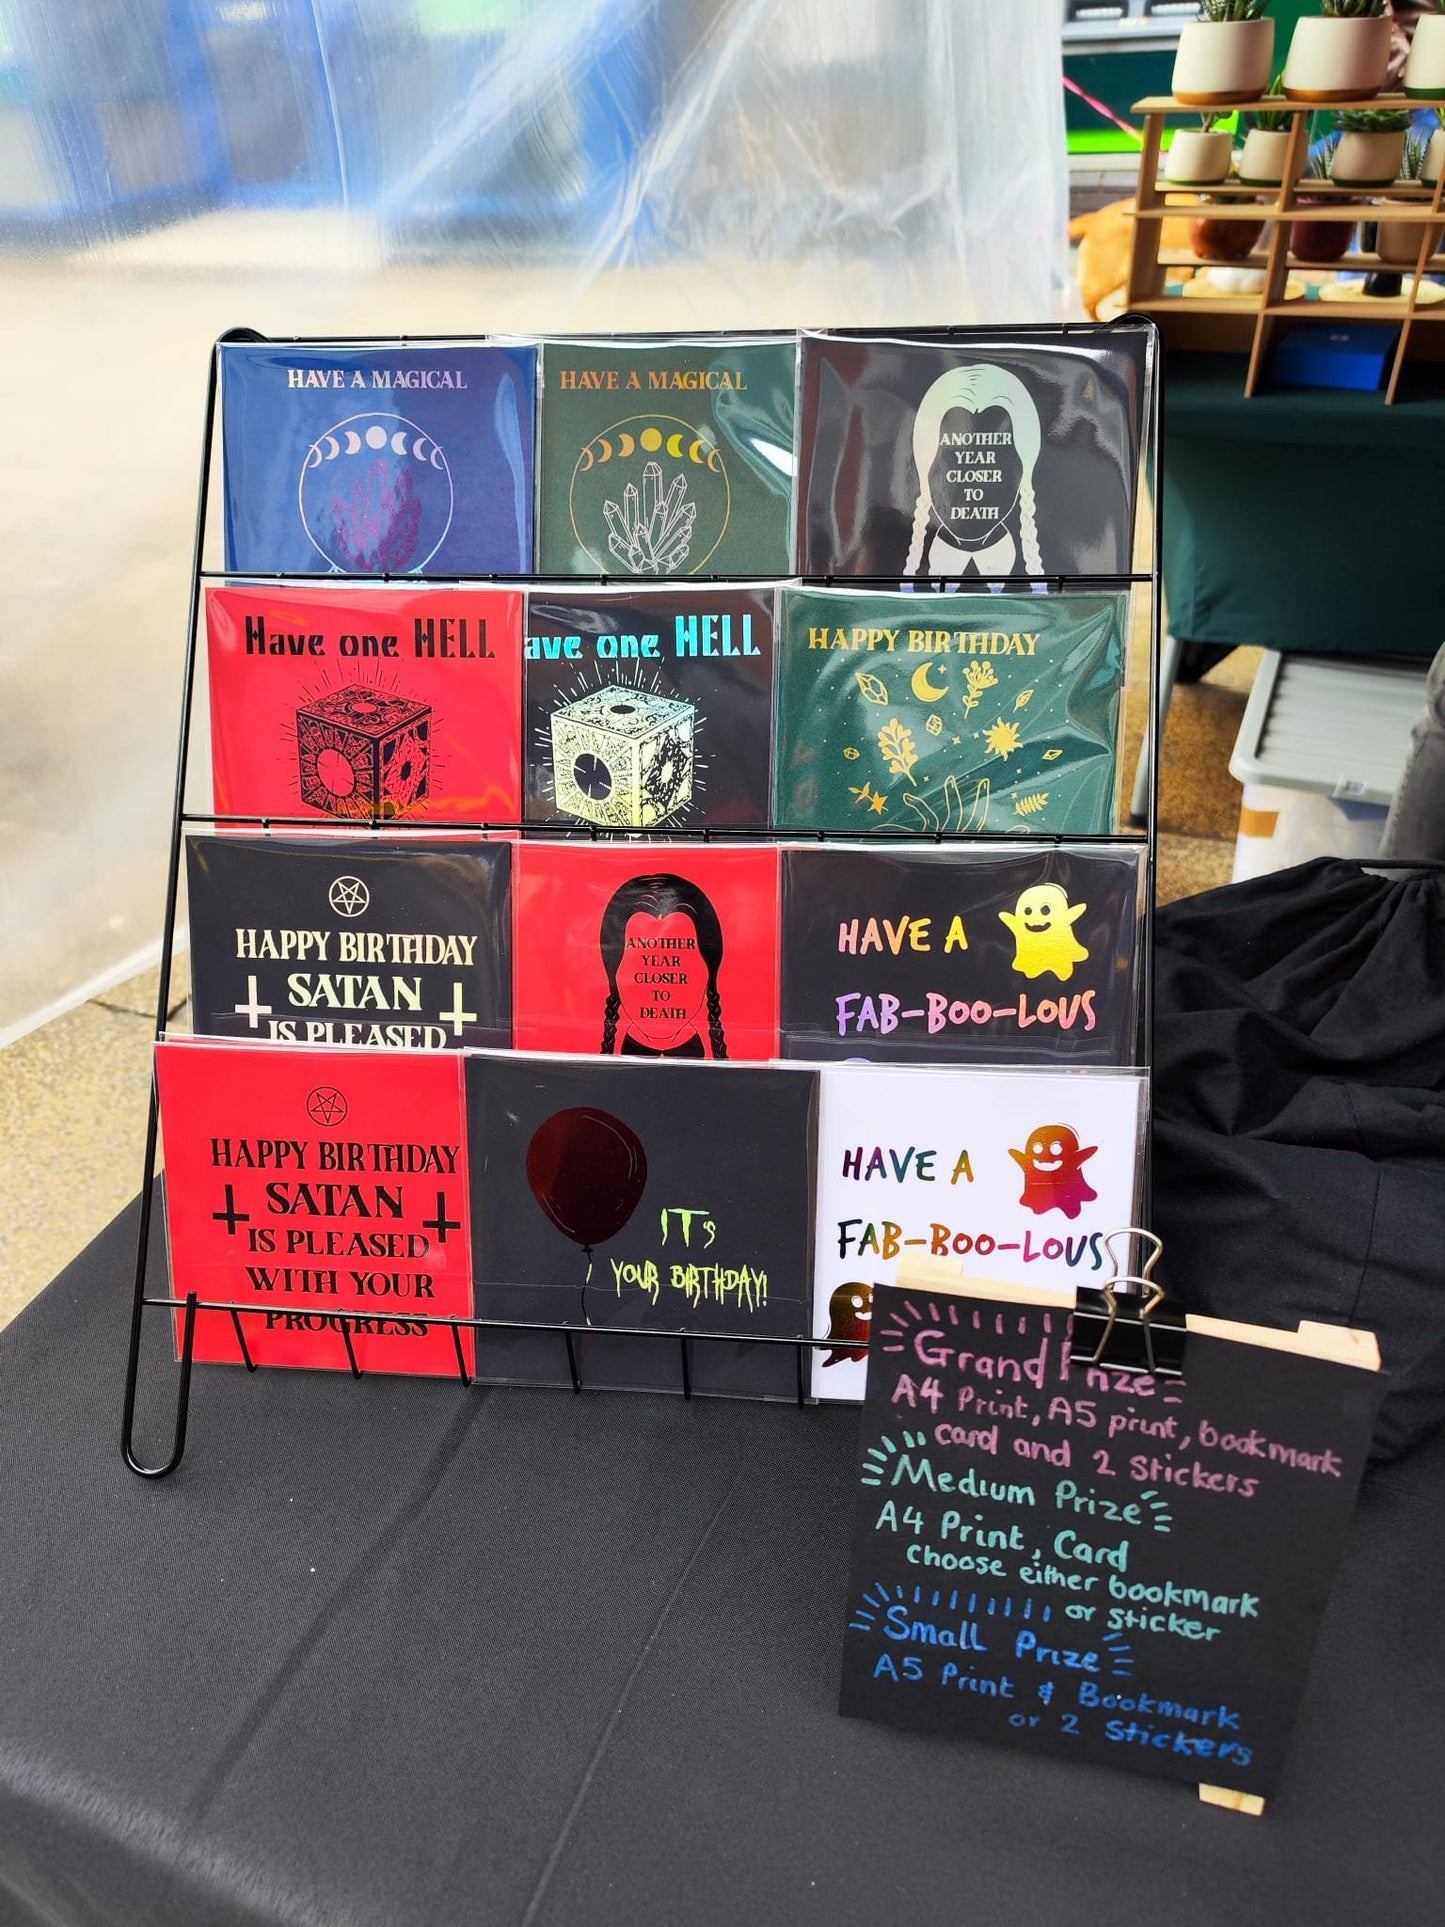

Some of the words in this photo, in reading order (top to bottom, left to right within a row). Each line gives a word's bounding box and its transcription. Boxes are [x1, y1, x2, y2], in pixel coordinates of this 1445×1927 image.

[287, 370, 345, 389] HAVE
[350, 370, 366, 389] A
[372, 370, 468, 389] MAGICAL
[560, 371, 621, 390] HAVE
[624, 371, 641, 389] A
[649, 371, 747, 390] MAGICAL
[940, 432, 1012, 446] ANOTHER
[955, 451, 996, 464] YEAR
[946, 470, 1002, 483] CLOSER
[964, 489, 984, 501] TO
[950, 507, 999, 520] DEATH
[245, 616, 324, 656] Have
[340, 635, 398, 657] one
[414, 618, 496, 658] HELL
[524, 636, 583, 660] ave
[596, 634, 661, 659] one
[675, 614, 761, 657] HELL
[808, 628, 899, 651] HAPPY
[907, 630, 1041, 655] BIRTHDAY
[235, 929, 330, 960] HAPPY
[339, 932, 478, 965] BIRTHDAY
[626, 937, 696, 950] ANOTHER
[838, 915, 931, 955] HAVE
[943, 915, 968, 953] A
[641, 955, 681, 967] YEAR
[287, 973, 422, 1011] SATAN
[634, 972, 688, 985] CLOSER
[652, 990, 671, 1001] TO
[639, 1007, 687, 1019] DEATH
[836, 990, 1096, 1036] FAB-BOO-LOUS
[268, 1020, 296, 1042] IS
[306, 1021, 447, 1048] PLEASED
[210, 1138, 309, 1169] HAPPY
[318, 1142, 460, 1173] BIRTHDAY
[842, 1146, 938, 1183] HAVE
[950, 1149, 975, 1185] A
[265, 1182, 403, 1218] SATAN
[248, 1229, 275, 1252] IS
[286, 1230, 430, 1258] PLEASED
[837, 1218, 1104, 1271] FAB-BOO-LOUS
[245, 1267, 338, 1294] WITH
[349, 1271, 434, 1298] YOUR
[610, 1258, 660, 1306] YOUR
[669, 1262, 768, 1313] BIRTHDAY!
[264, 1310, 429, 1337] PROGRESS
[913, 1329, 1049, 1390] Grand
[891, 1373, 944, 1414] A4
[957, 1385, 1040, 1427] Print,
[1048, 1396, 1097, 1426] A5
[1108, 1406, 1191, 1450] print,
[1199, 1419, 1343, 1478] bookmark
[1012, 1437, 1071, 1468] and
[1092, 1449, 1117, 1476] 2
[890, 1454, 1036, 1506] Medium
[1055, 1479, 1142, 1525] Prize
[875, 1500, 924, 1535] A4
[1053, 1530, 1130, 1572] Card
[1019, 1561, 1100, 1592] either
[1108, 1574, 1260, 1618] bookmark
[1065, 1604, 1097, 1622] or
[883, 1605, 988, 1652] Small
[1015, 1630, 1101, 1672] Prize
[872, 1653, 923, 1682] A5
[941, 1662, 1015, 1699] Print
[1078, 1681, 1241, 1730] Bookmark
[1008, 1713, 1042, 1728] or
[1060, 1714, 1080, 1735] 2
